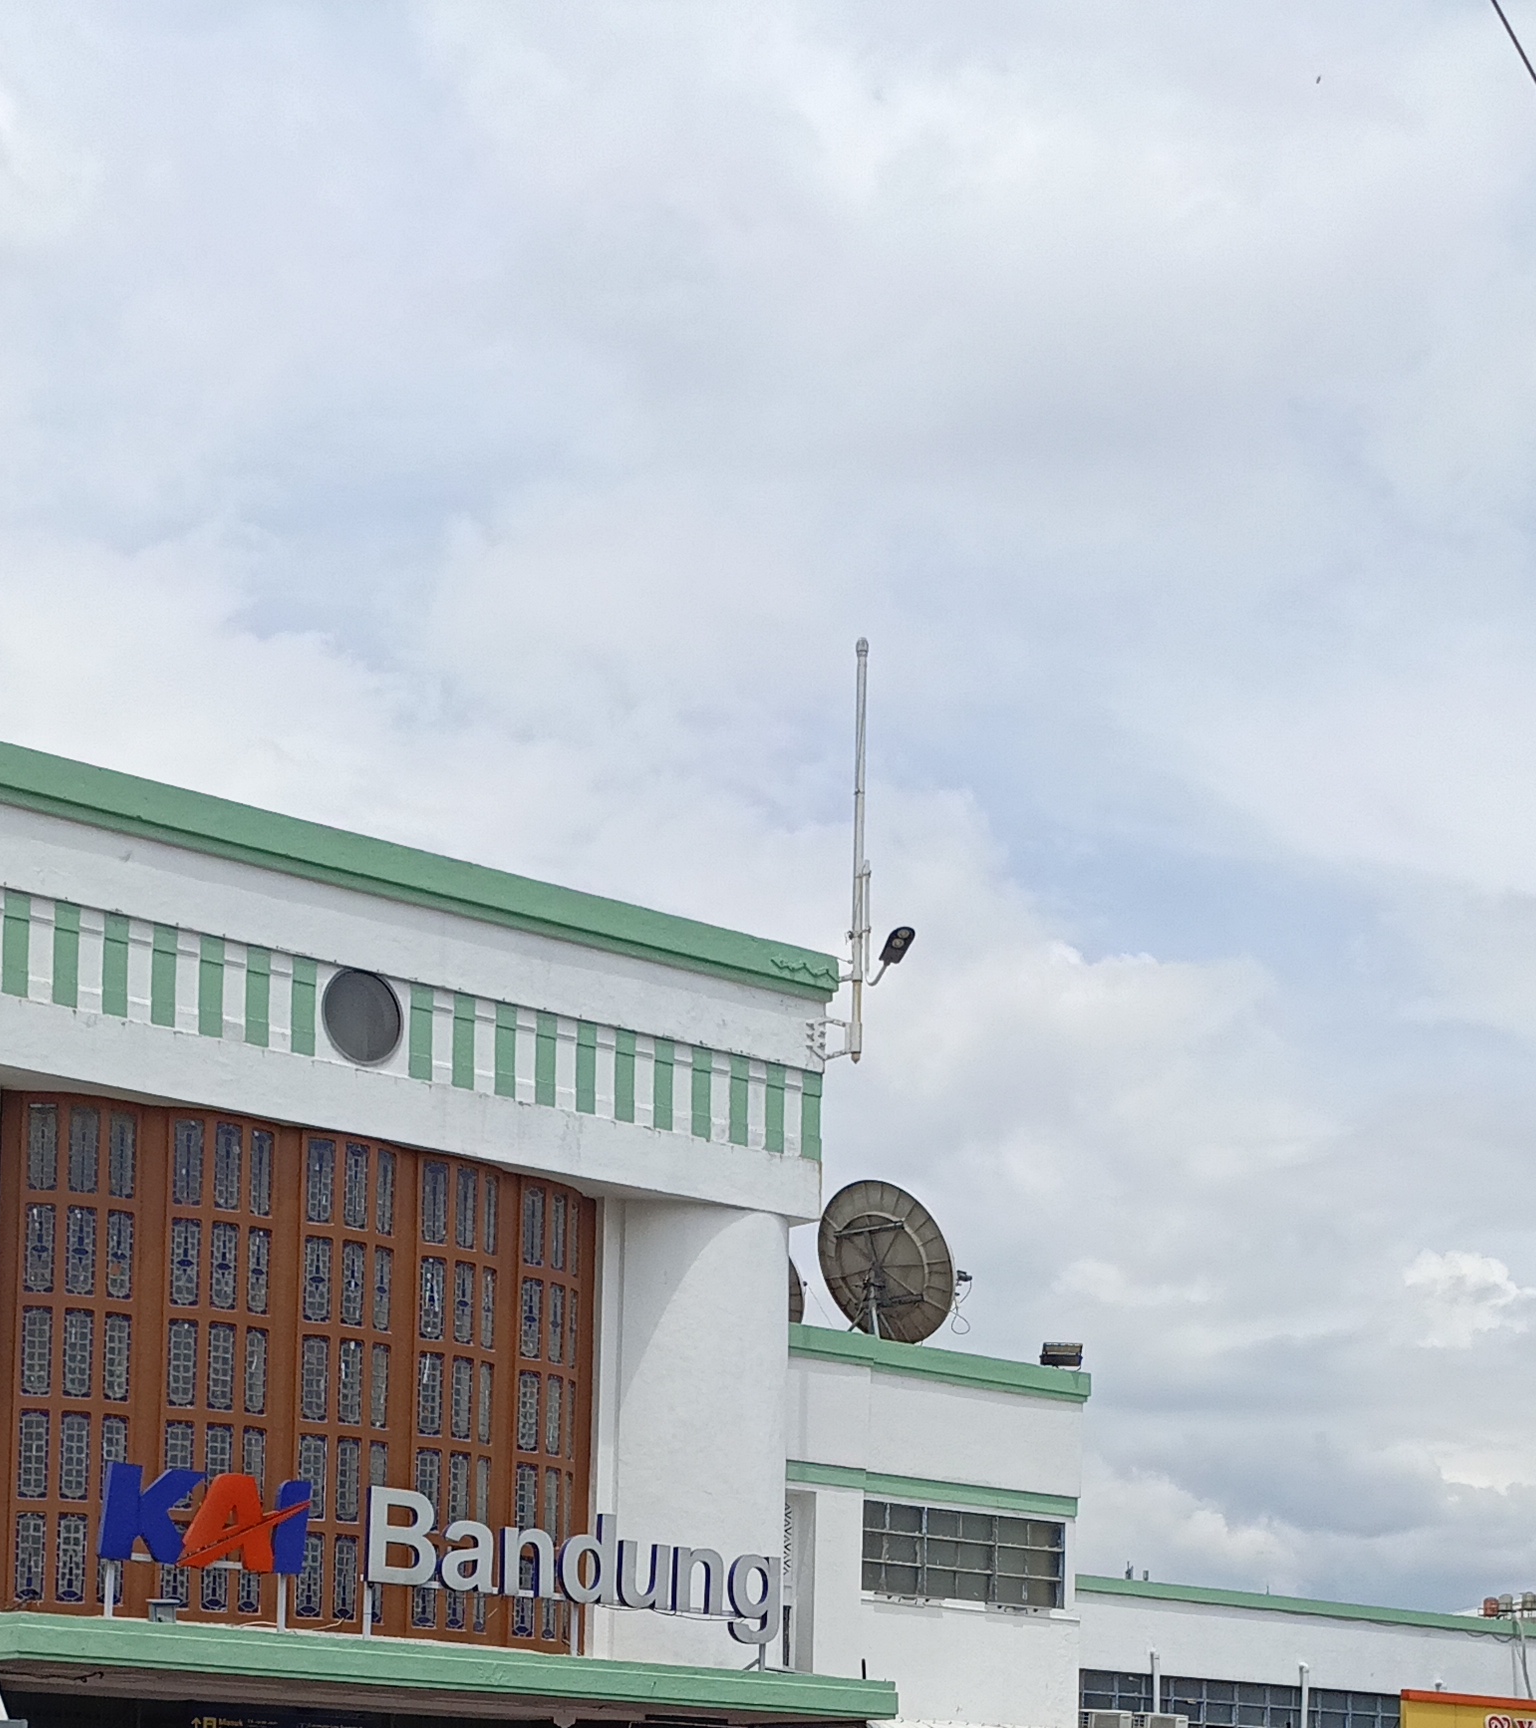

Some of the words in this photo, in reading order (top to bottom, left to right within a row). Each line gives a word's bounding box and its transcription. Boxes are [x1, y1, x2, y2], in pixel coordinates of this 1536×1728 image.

[96, 1461, 311, 1575] KAI
[366, 1486, 781, 1645] Bandung
[218, 1717, 243, 1728] Masuk
